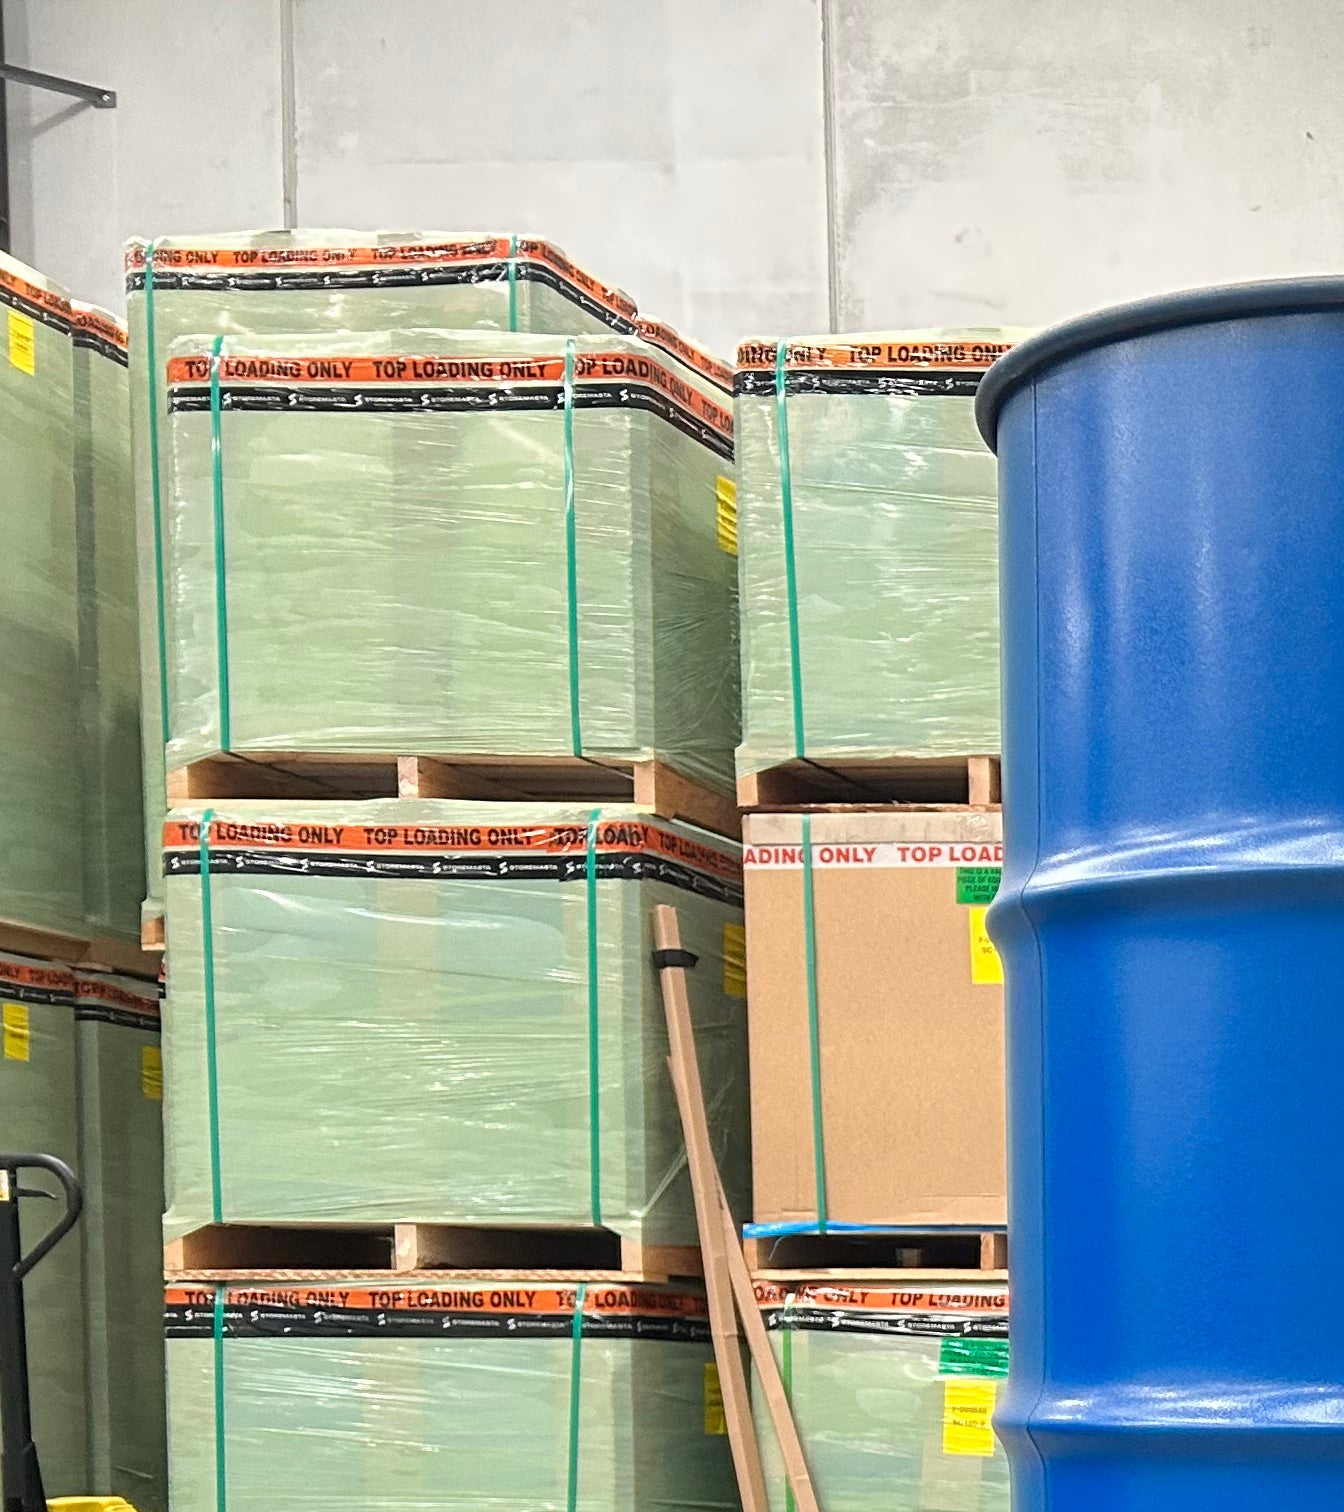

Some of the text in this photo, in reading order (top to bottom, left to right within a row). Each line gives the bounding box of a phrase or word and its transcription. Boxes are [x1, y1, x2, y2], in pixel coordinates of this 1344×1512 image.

[186, 251, 218, 264] ONLY
[233, 251, 258, 264] TOP
[850, 345, 881, 363] TOP
[888, 345, 965, 363] LOADING
[226, 361, 301, 379] LOADING
[307, 361, 352, 379] ONLY
[373, 361, 406, 378] TOP
[413, 361, 493, 379] LOADING
[500, 361, 546, 378] ONLY
[602, 357, 667, 390] LOADING
[669, 375, 693, 406] ONLY
[217, 824, 292, 842] LOADING
[298, 828, 343, 844] ONLY
[363, 828, 397, 844] TOP
[404, 828, 481, 845] LOADING
[487, 829, 534, 845] ONLY
[819, 847, 876, 864] ONLY
[897, 846, 942, 863] TOP
[227, 1291, 300, 1307] LOADING
[306, 1291, 349, 1307] ONLY
[368, 1291, 400, 1308] TOP
[407, 1291, 483, 1308] LOADING
[490, 1291, 535, 1308] ONLY
[891, 1292, 924, 1307] TOP
[928, 1292, 1006, 1308] LOADING
